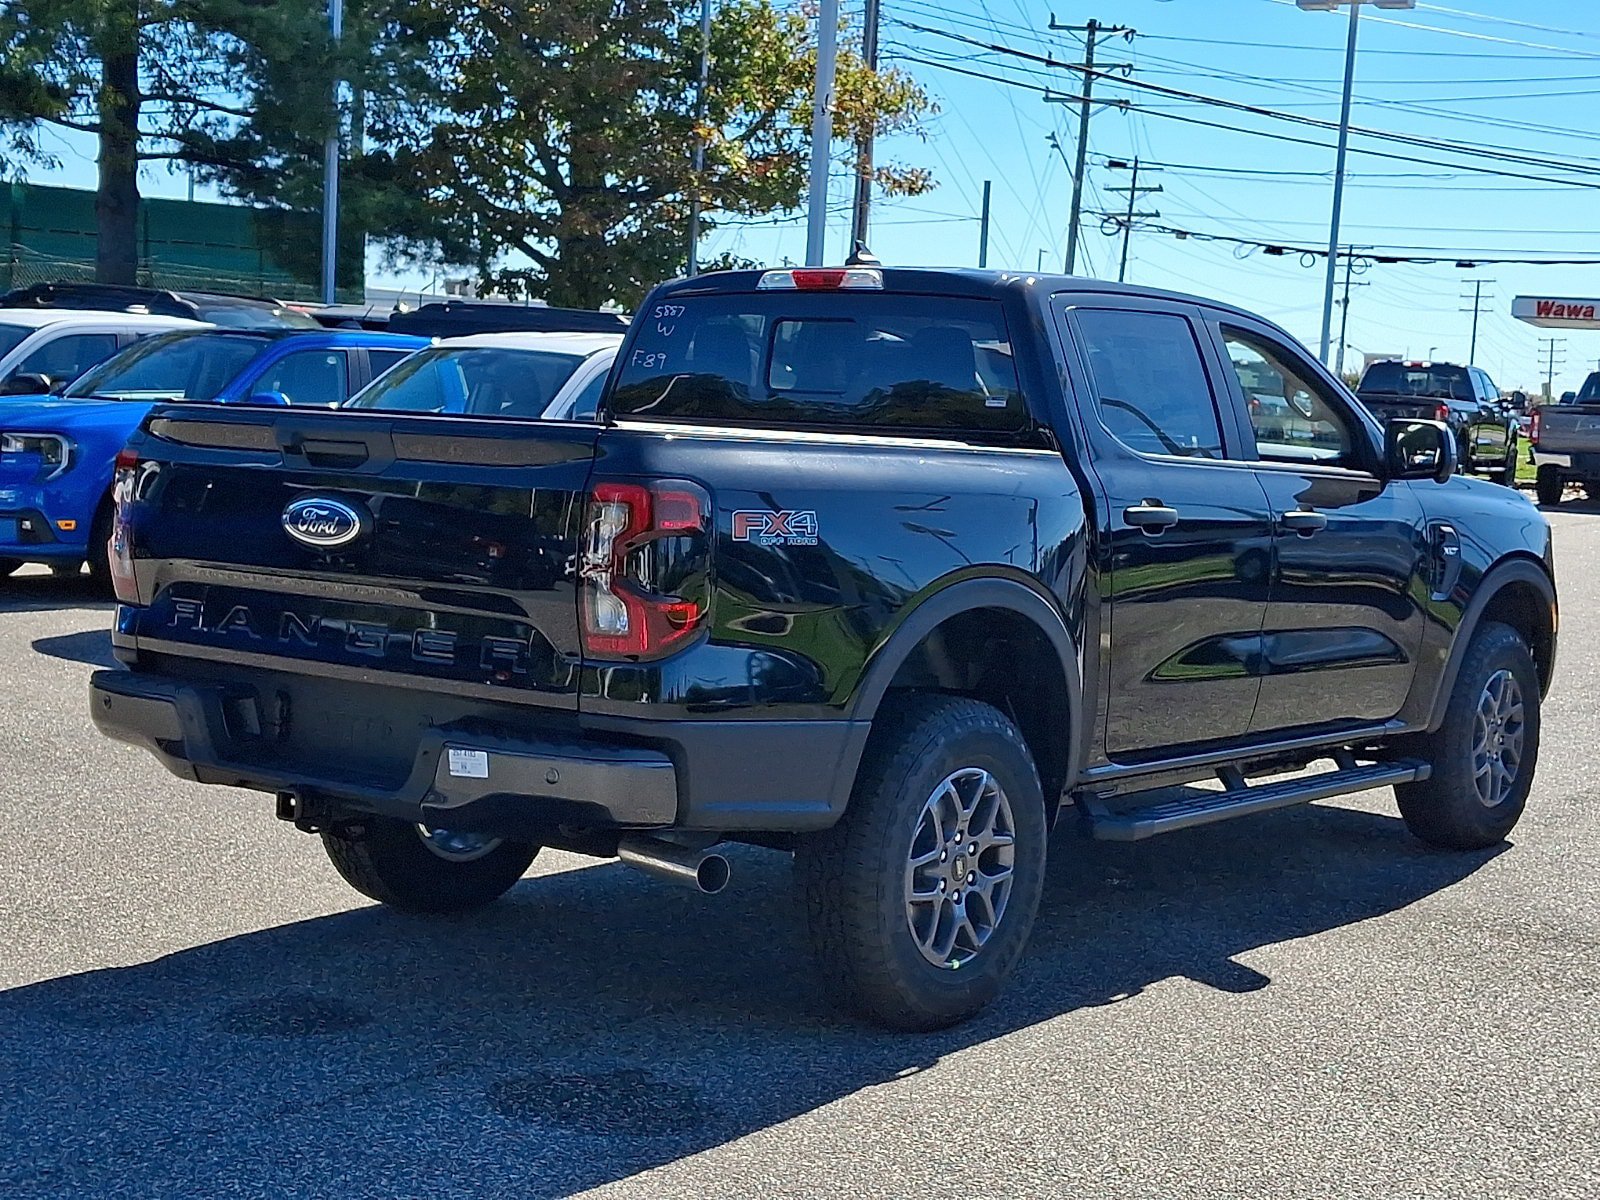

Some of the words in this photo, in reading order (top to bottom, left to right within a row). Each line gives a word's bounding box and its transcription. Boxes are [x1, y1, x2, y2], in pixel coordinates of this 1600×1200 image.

[654, 305, 686, 318] 5887
[1536, 300, 1595, 318] Wawa
[657, 322, 675, 336] W
[298, 507, 340, 534] Ford
[732, 510, 818, 541] FX4
[760, 536, 785, 546] OFF
[787, 536, 818, 546] ROAD
[167, 597, 529, 674] RANGER
